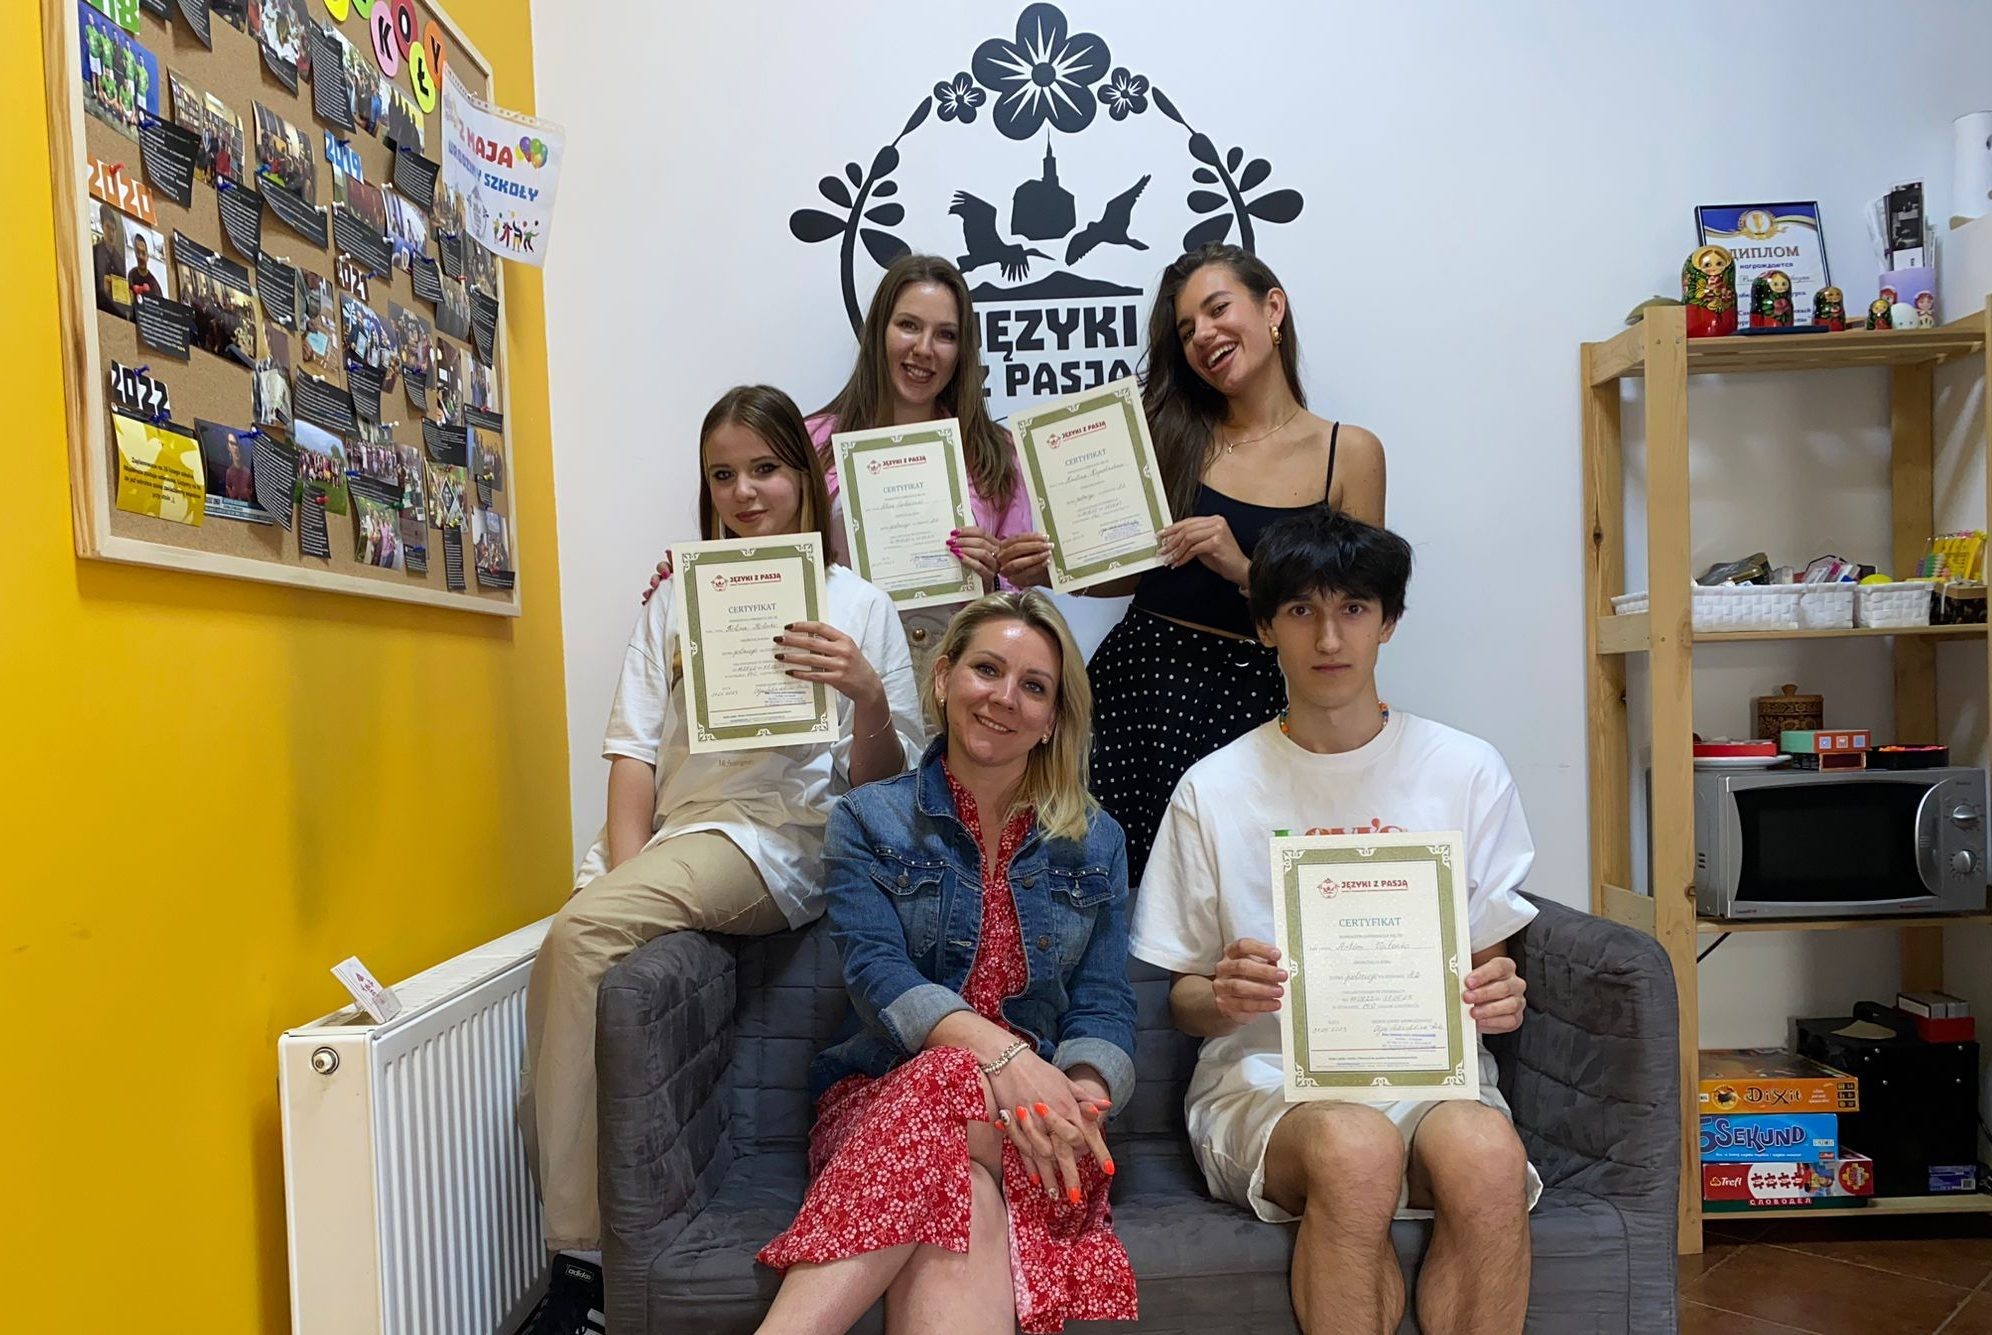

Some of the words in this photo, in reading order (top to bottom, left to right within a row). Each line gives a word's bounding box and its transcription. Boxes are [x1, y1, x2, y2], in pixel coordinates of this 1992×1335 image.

[466, 126, 513, 169] MAJA
[87, 154, 157, 225] 2020
[484, 173, 539, 202] SZKOŁY
[111, 359, 171, 419] 2022
[728, 603, 777, 614] CERTYFIKAT
[1341, 881, 1371, 889] JĘZYKI
[1373, 880, 1379, 888] Z
[1339, 917, 1401, 928] CERTYFIKAT
[1715, 1117, 1806, 1152] SEKUND
[1721, 1176, 1742, 1187] Trefl
[568, 1268, 592, 1281] adidas
